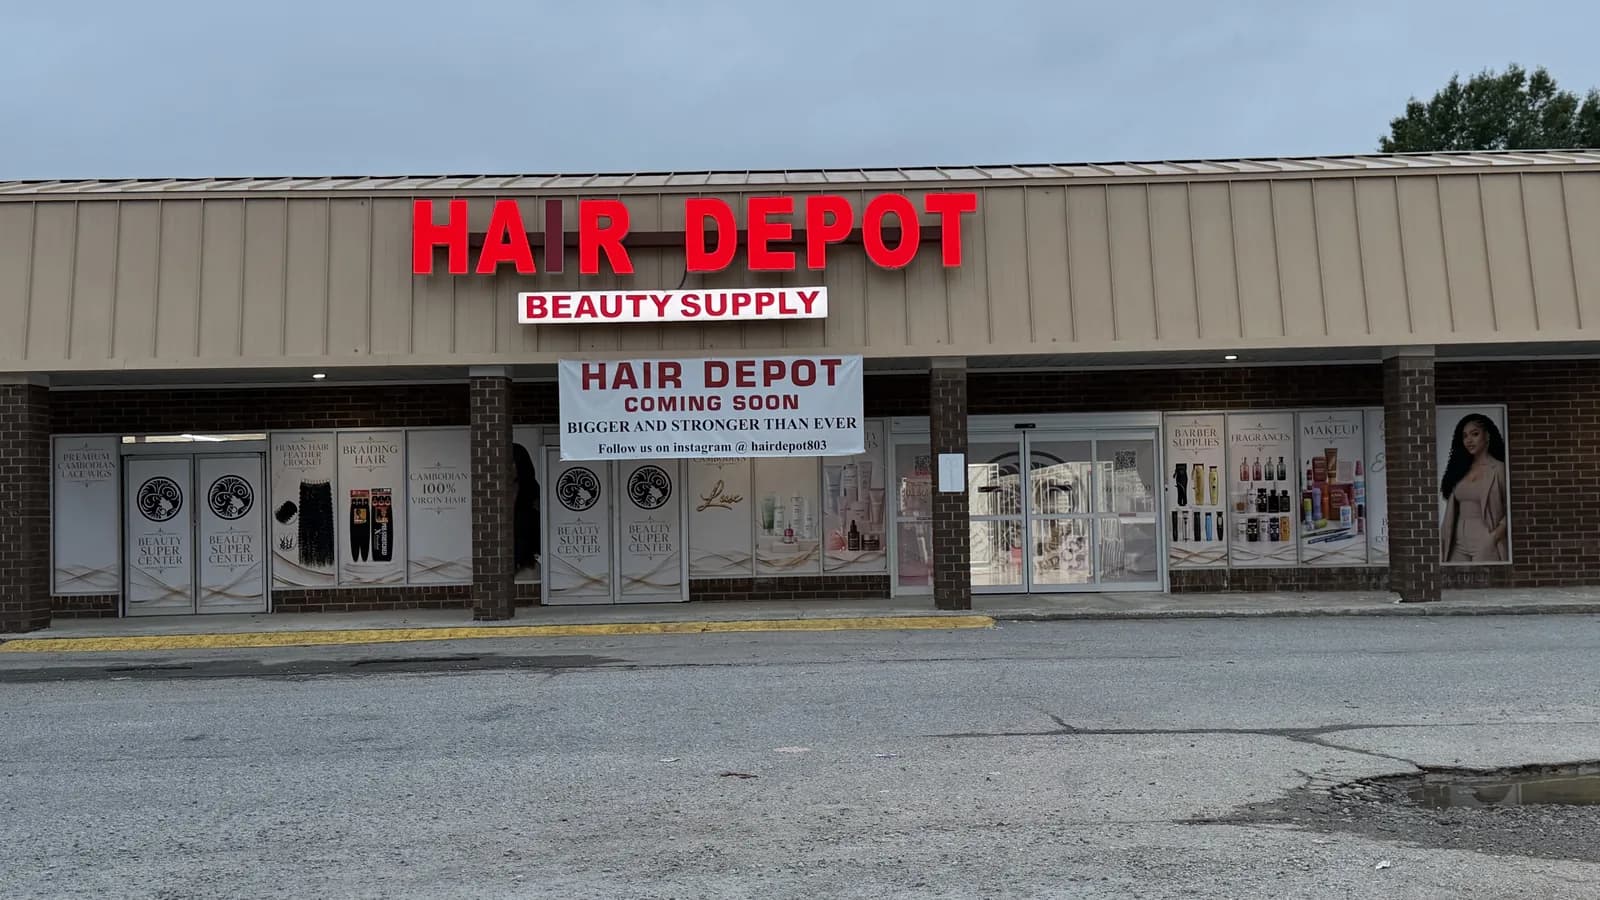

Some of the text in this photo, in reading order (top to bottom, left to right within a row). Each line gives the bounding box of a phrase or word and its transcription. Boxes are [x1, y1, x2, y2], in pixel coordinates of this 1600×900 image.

[413, 192, 977, 274] HAIR DEPOT
[526, 291, 820, 319] BEAUTY SUPPLY
[581, 358, 842, 391] HAIR DEPOT
[624, 394, 799, 413] COMING SOON
[567, 416, 857, 434] BIGGER AND STRONGER THAN EVER
[1303, 424, 1359, 436] MAKEUP
[1175, 428, 1217, 438] BARBER
[1231, 432, 1291, 443] FRAGRANCES
[1172, 437, 1220, 447] SUPPLIES
[275, 443, 329, 452] HUMAN HAIR
[343, 444, 398, 455] BRAIDING
[598, 443, 636, 455] Follow
[657, 444, 670, 453] on
[673, 441, 732, 455] instagram
[735, 441, 748, 454] @
[751, 440, 827, 453] hairdepot803
[63, 452, 110, 461] PREMIUM
[283, 451, 322, 459] FEATHER
[355, 454, 386, 465] HAIR
[410, 472, 469, 481] CAMBODIAN
[423, 482, 456, 495] 100%
[411, 495, 468, 505] VIRGIN HAIR
[557, 526, 600, 536] BEAUTY
[628, 524, 671, 534] BEAUTY
[137, 536, 183, 546] BEAUTY
[208, 535, 252, 545] BEAUTY
[560, 535, 598, 546] SUPER
[631, 533, 669, 544] SUPER
[140, 546, 180, 556] SUPER
[211, 544, 251, 554] SUPER
[557, 545, 602, 555] CENTER
[628, 543, 673, 554] CENTER
[137, 555, 183, 566] CENTER
[208, 554, 254, 564] CENTER
